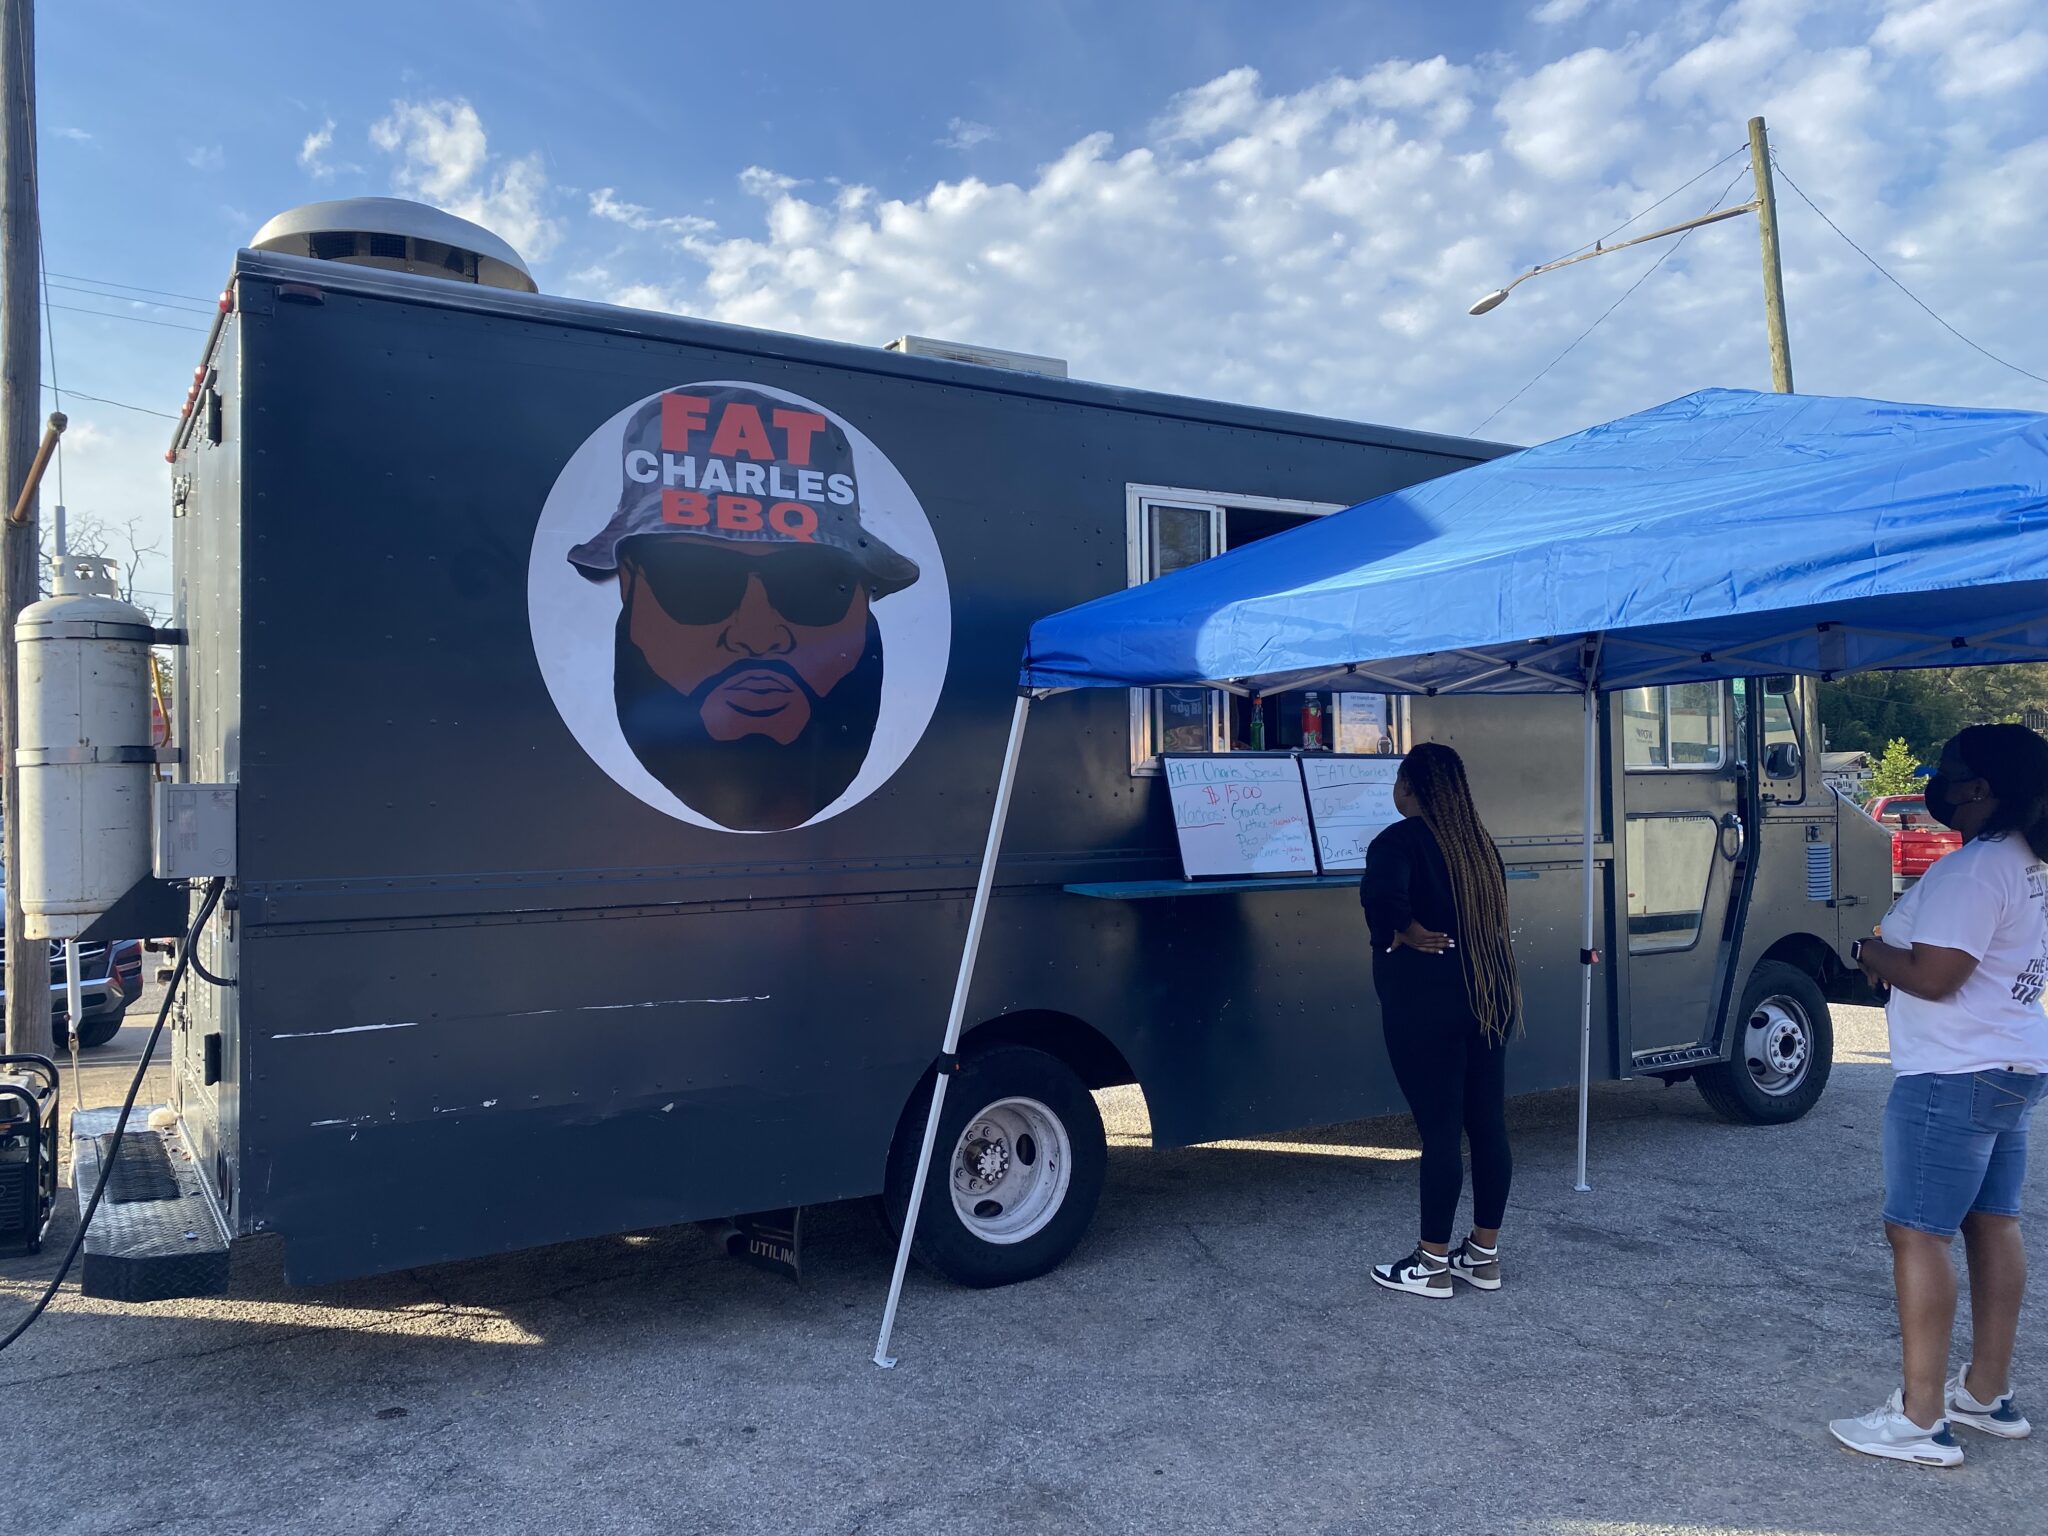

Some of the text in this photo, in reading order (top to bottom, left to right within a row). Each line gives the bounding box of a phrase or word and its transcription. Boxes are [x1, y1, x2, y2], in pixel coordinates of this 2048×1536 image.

[661, 392, 826, 466] FAT
[625, 449, 855, 506] CHARLES
[661, 488, 819, 543] BBQ
[1168, 760, 1198, 785] FAT
[1314, 764, 1345, 785] FAT
[1350, 764, 1388, 779] Charles
[1320, 836, 1353, 861] Birria
[1352, 839, 1368, 854] Tac
[2025, 958, 2045, 973] THE
[2017, 972, 2044, 987] WILL
